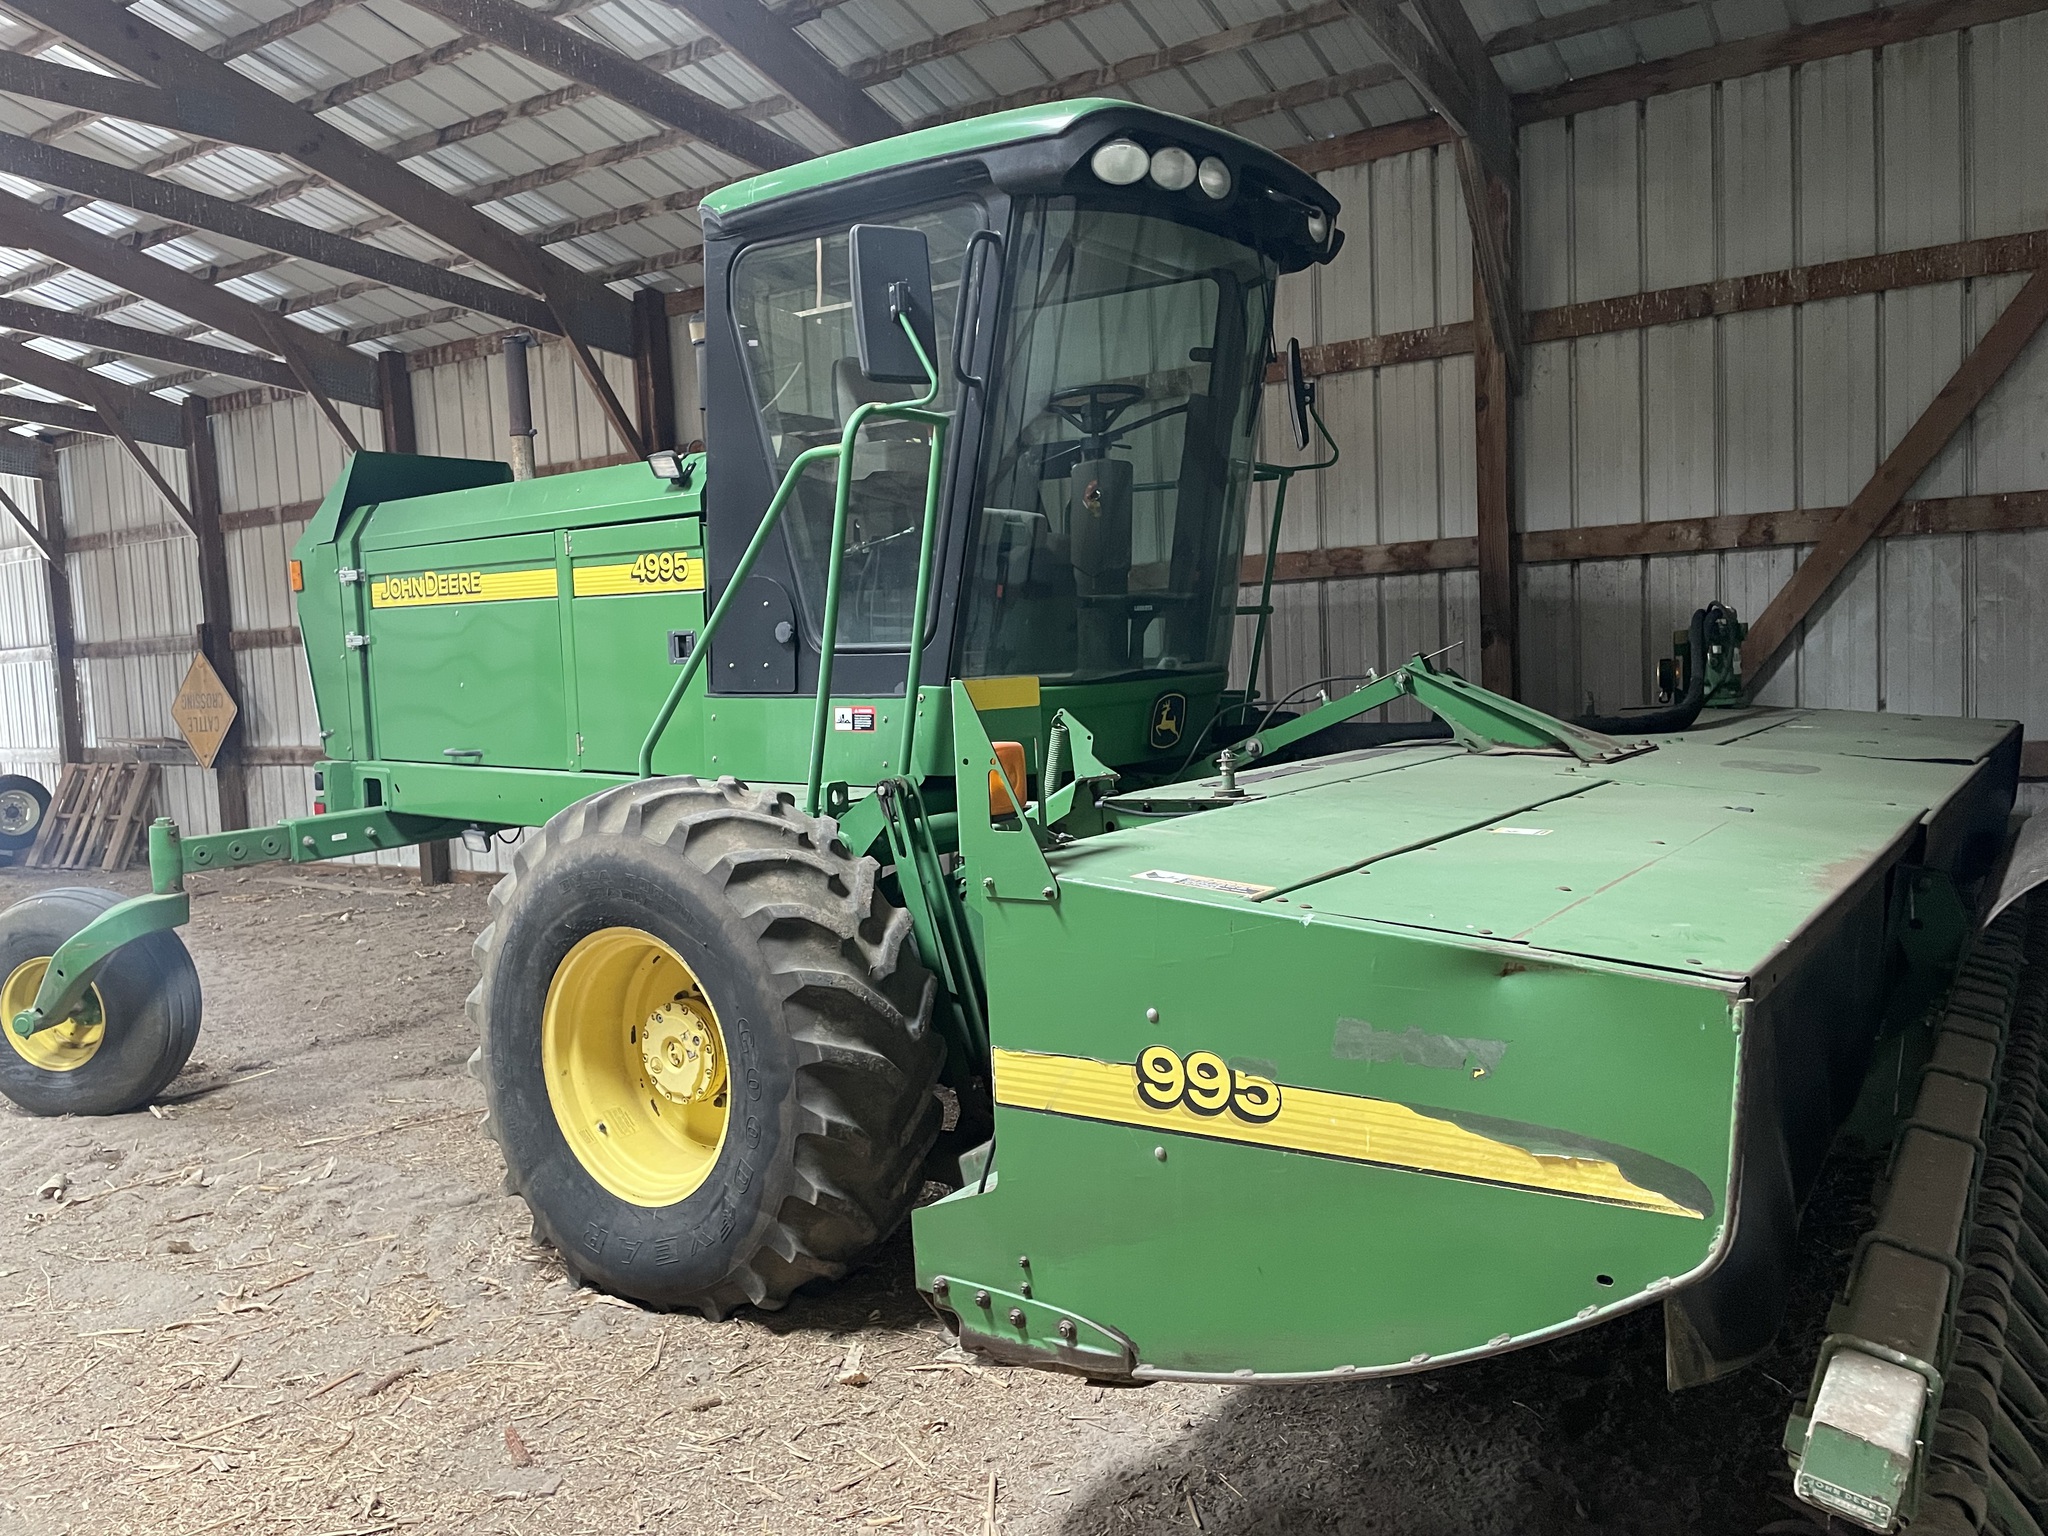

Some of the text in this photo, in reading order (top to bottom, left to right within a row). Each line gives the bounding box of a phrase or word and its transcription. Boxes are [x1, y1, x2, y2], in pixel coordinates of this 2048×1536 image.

[631, 552, 689, 582] 4995
[381, 571, 482, 600] JOHN DEERE
[182, 692, 224, 710] CROSSING
[188, 716, 220, 733] CATTLE
[1136, 1045, 1282, 1124] 995
